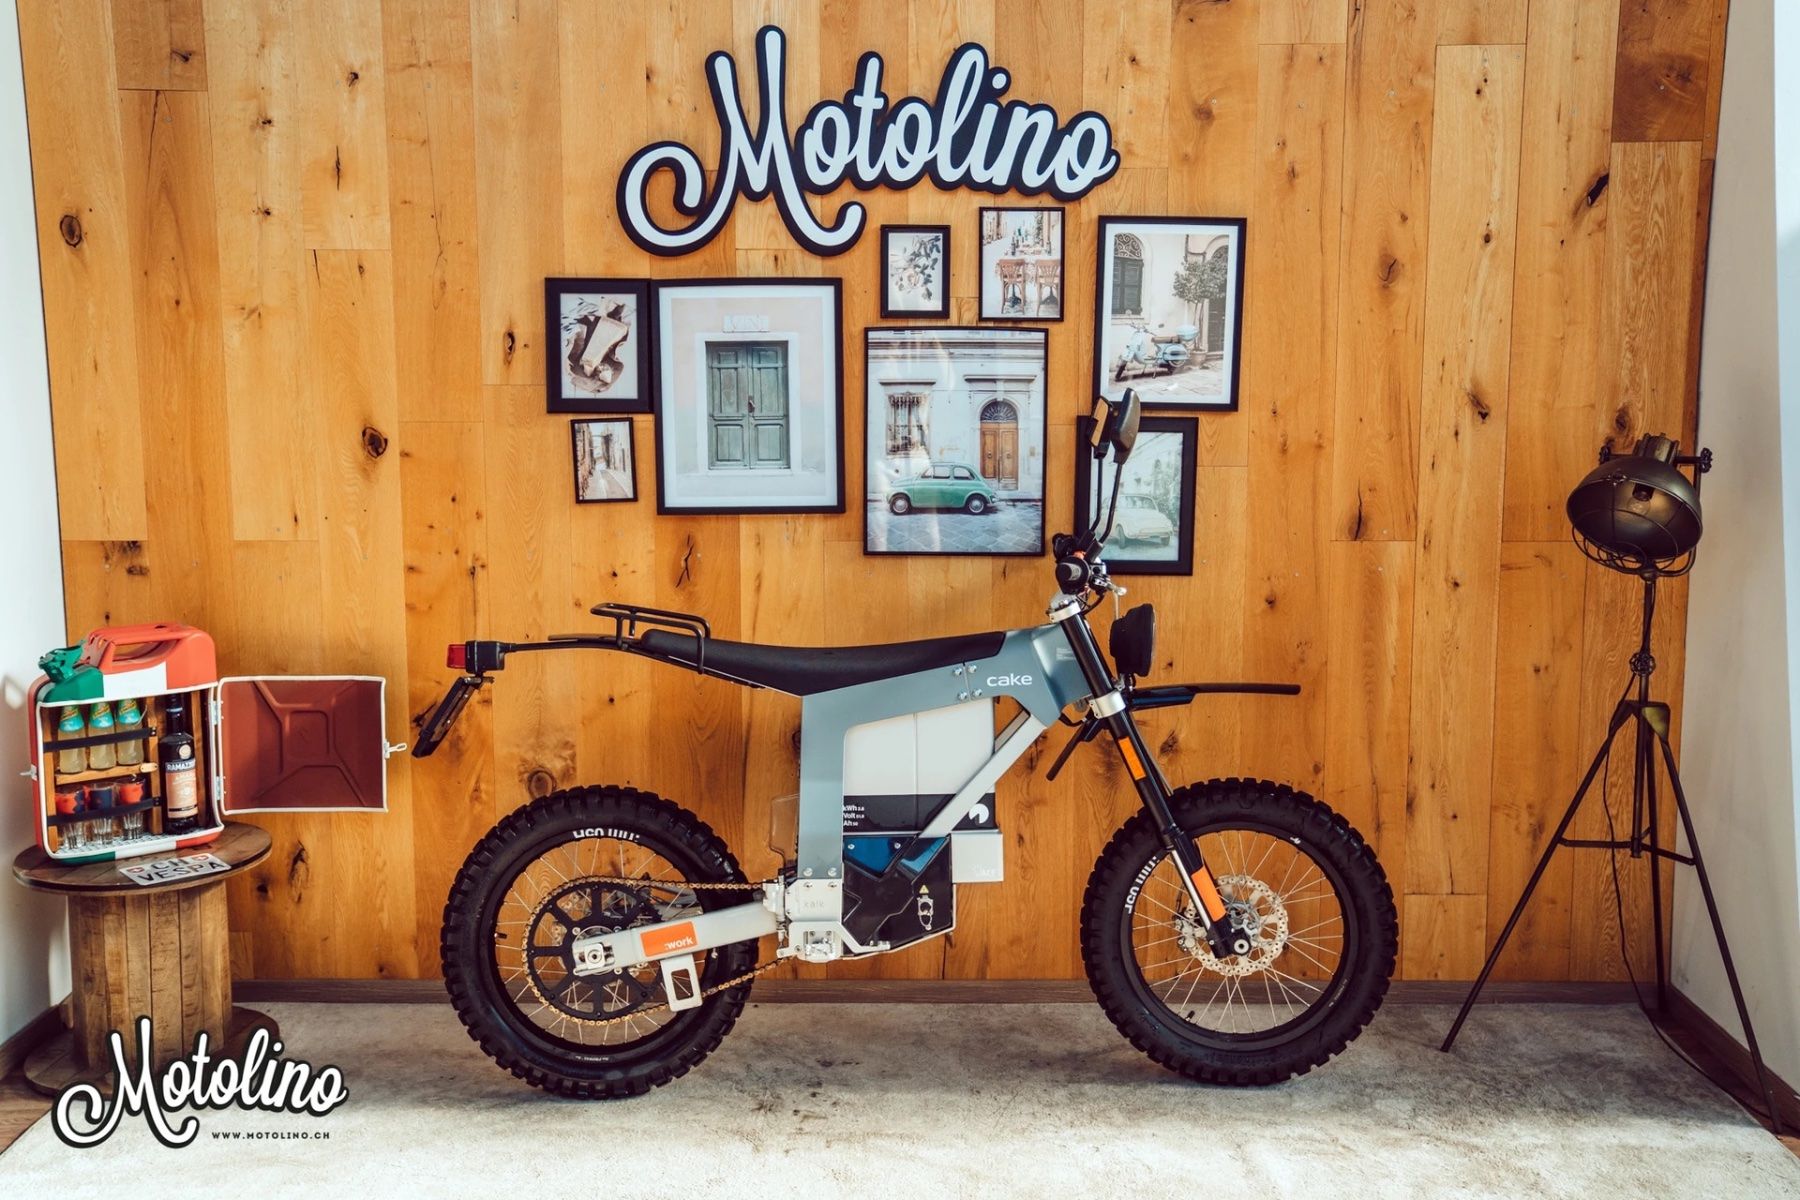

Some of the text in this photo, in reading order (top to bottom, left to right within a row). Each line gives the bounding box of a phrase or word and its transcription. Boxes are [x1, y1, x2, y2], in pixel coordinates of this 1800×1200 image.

[617, 26, 1120, 256] Motolino
[986, 673, 1033, 687] cake
[137, 861, 225, 882] VESPA
